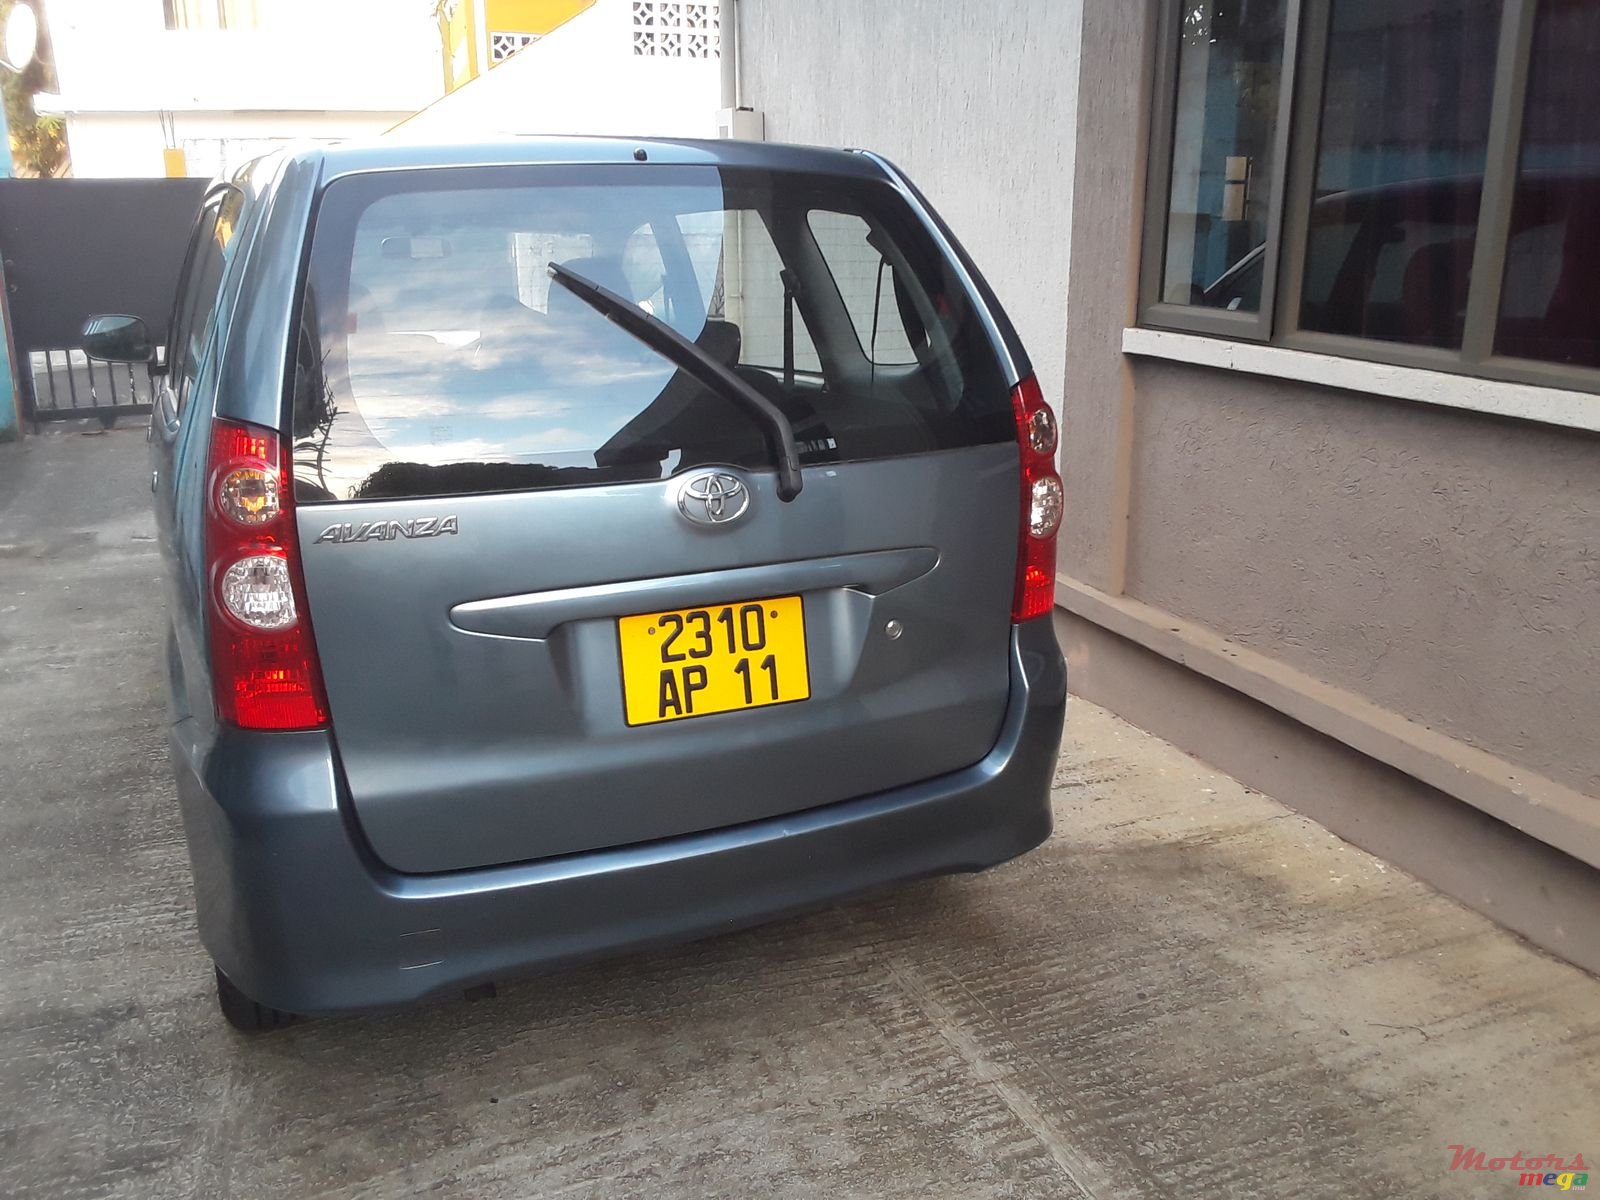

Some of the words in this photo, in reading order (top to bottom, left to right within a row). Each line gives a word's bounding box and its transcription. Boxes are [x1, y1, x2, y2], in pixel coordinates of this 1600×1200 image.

[313, 515, 458, 544] AVANZA
[658, 604, 766, 663] 2310
[659, 665, 707, 718] AP
[734, 655, 778, 704] 11
